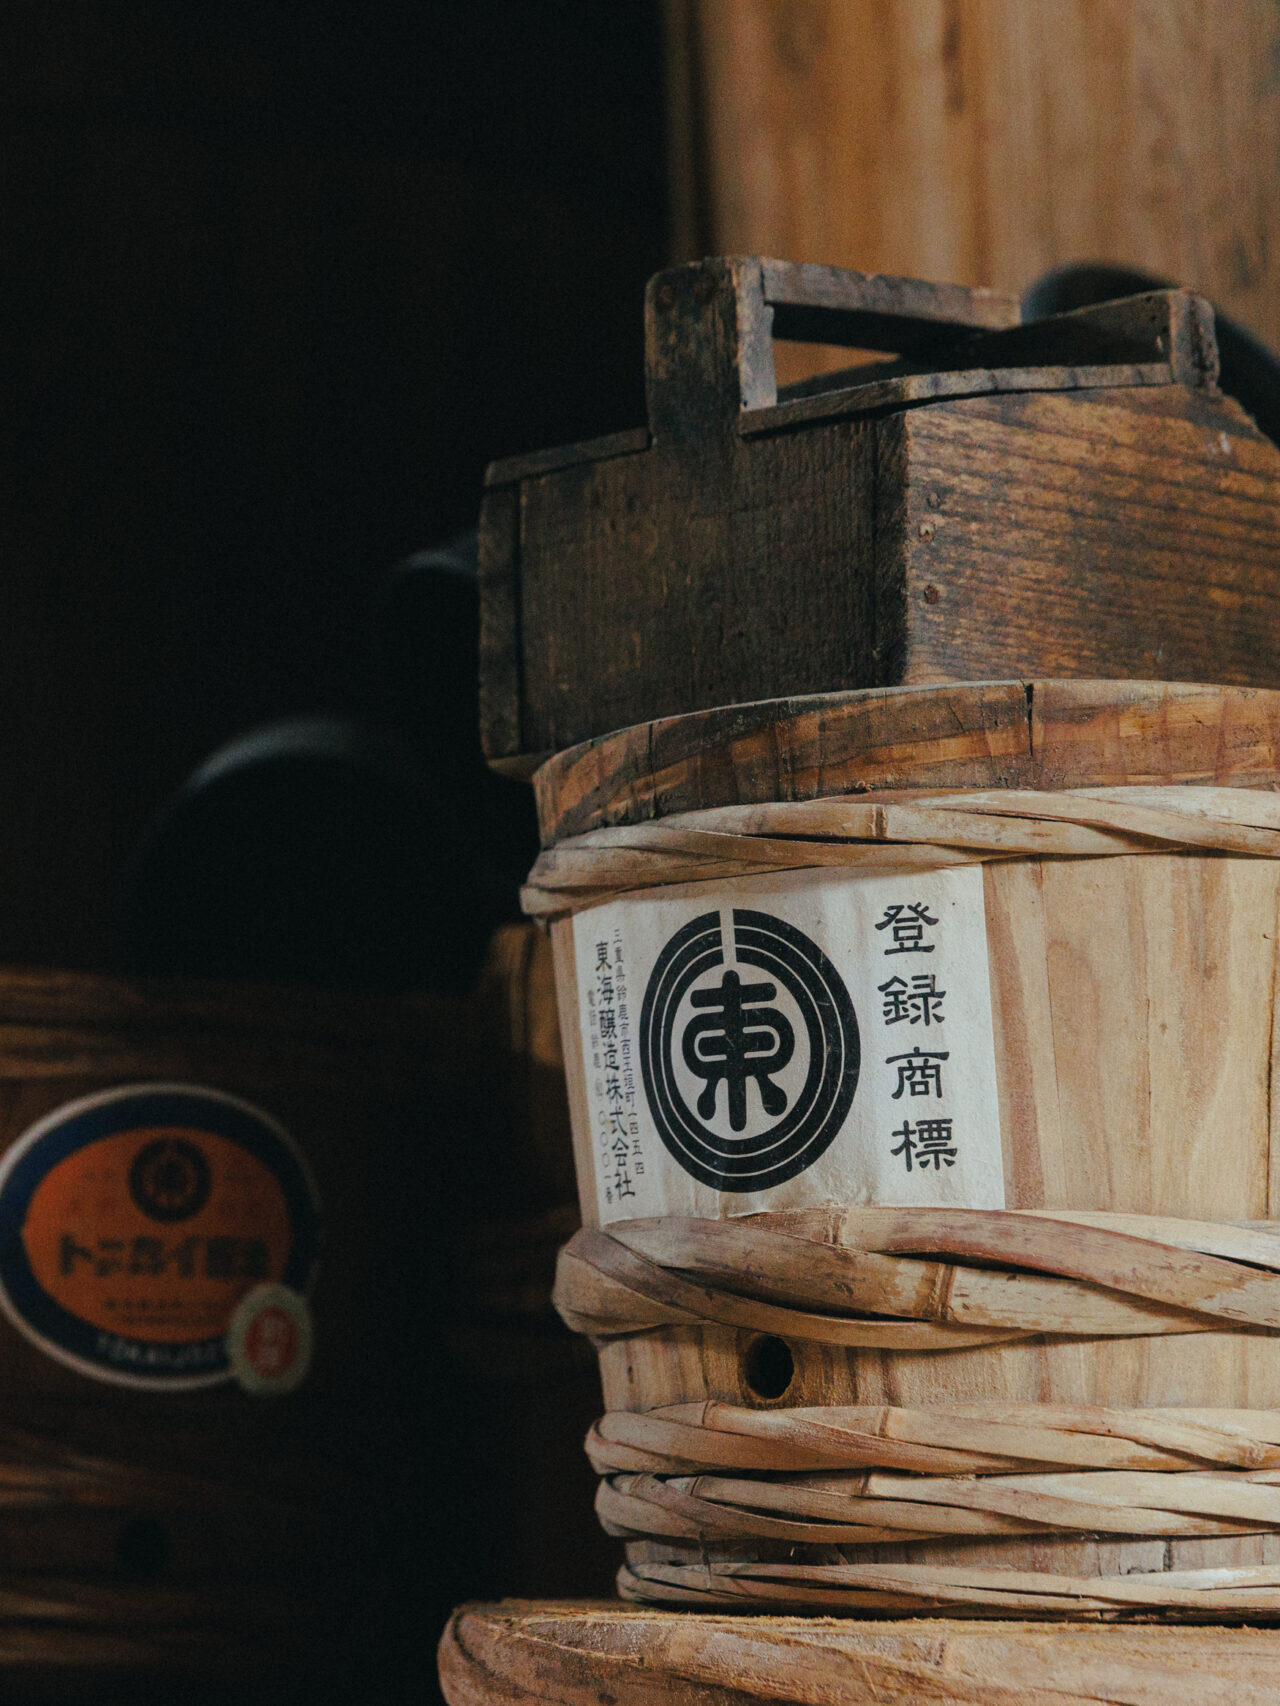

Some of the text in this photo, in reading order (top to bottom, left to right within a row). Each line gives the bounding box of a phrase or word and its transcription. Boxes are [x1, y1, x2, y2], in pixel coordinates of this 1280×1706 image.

[682, 970, 795, 1132] 東
[875, 903, 958, 1173] 登録商標
